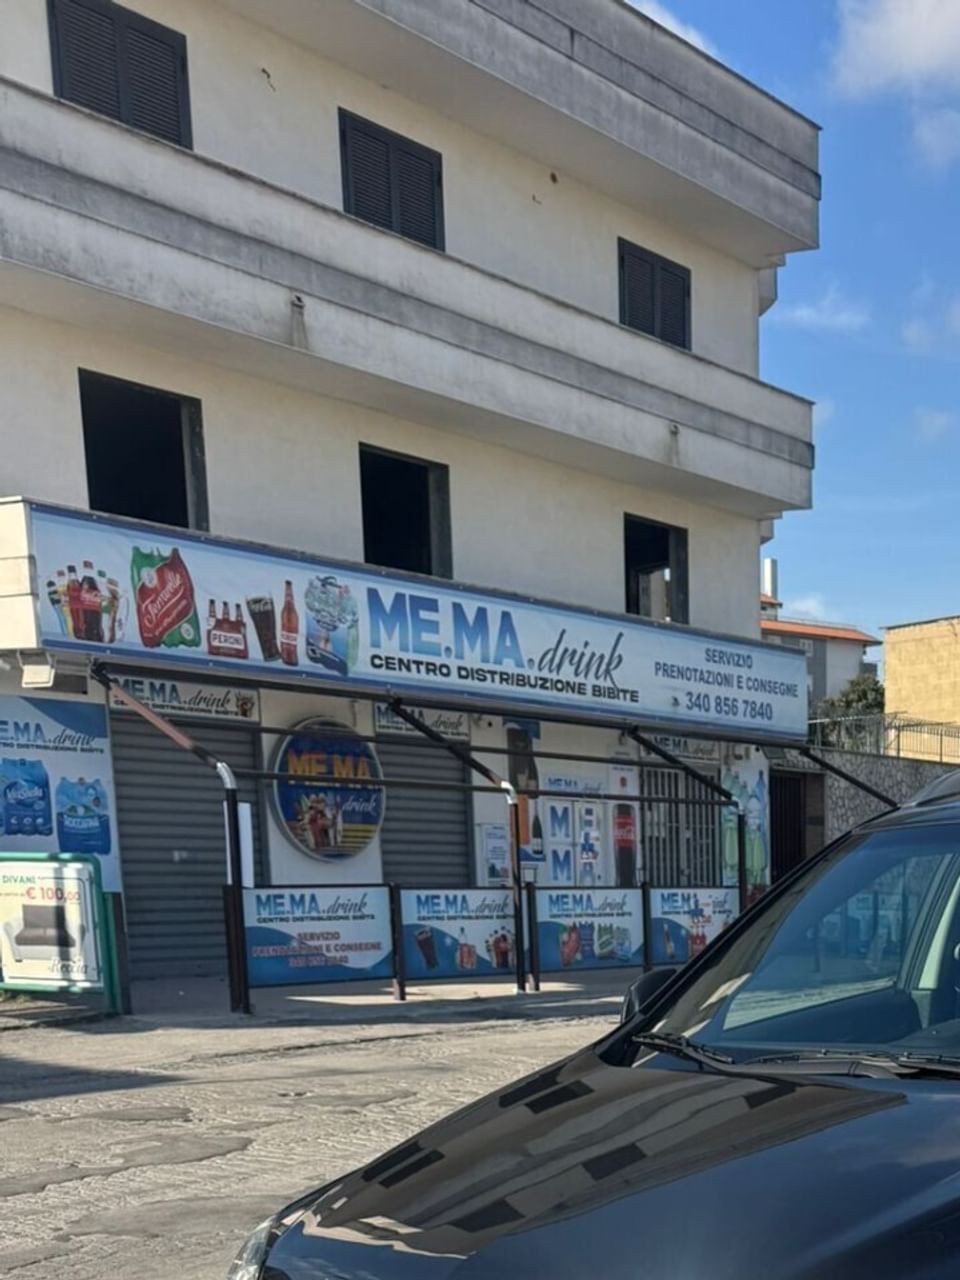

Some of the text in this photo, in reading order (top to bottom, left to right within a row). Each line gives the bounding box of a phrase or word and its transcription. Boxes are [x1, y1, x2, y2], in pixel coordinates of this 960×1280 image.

[210, 631, 244, 647] PERONI
[704, 648, 754, 669] SERVIZIO
[369, 654, 640, 703] CENTRO DISTRIBUZIONE BIBITE
[654, 661, 799, 698] PRENOTAZIONI E CONSEGNE
[685, 691, 774, 721] 340 856 7840
